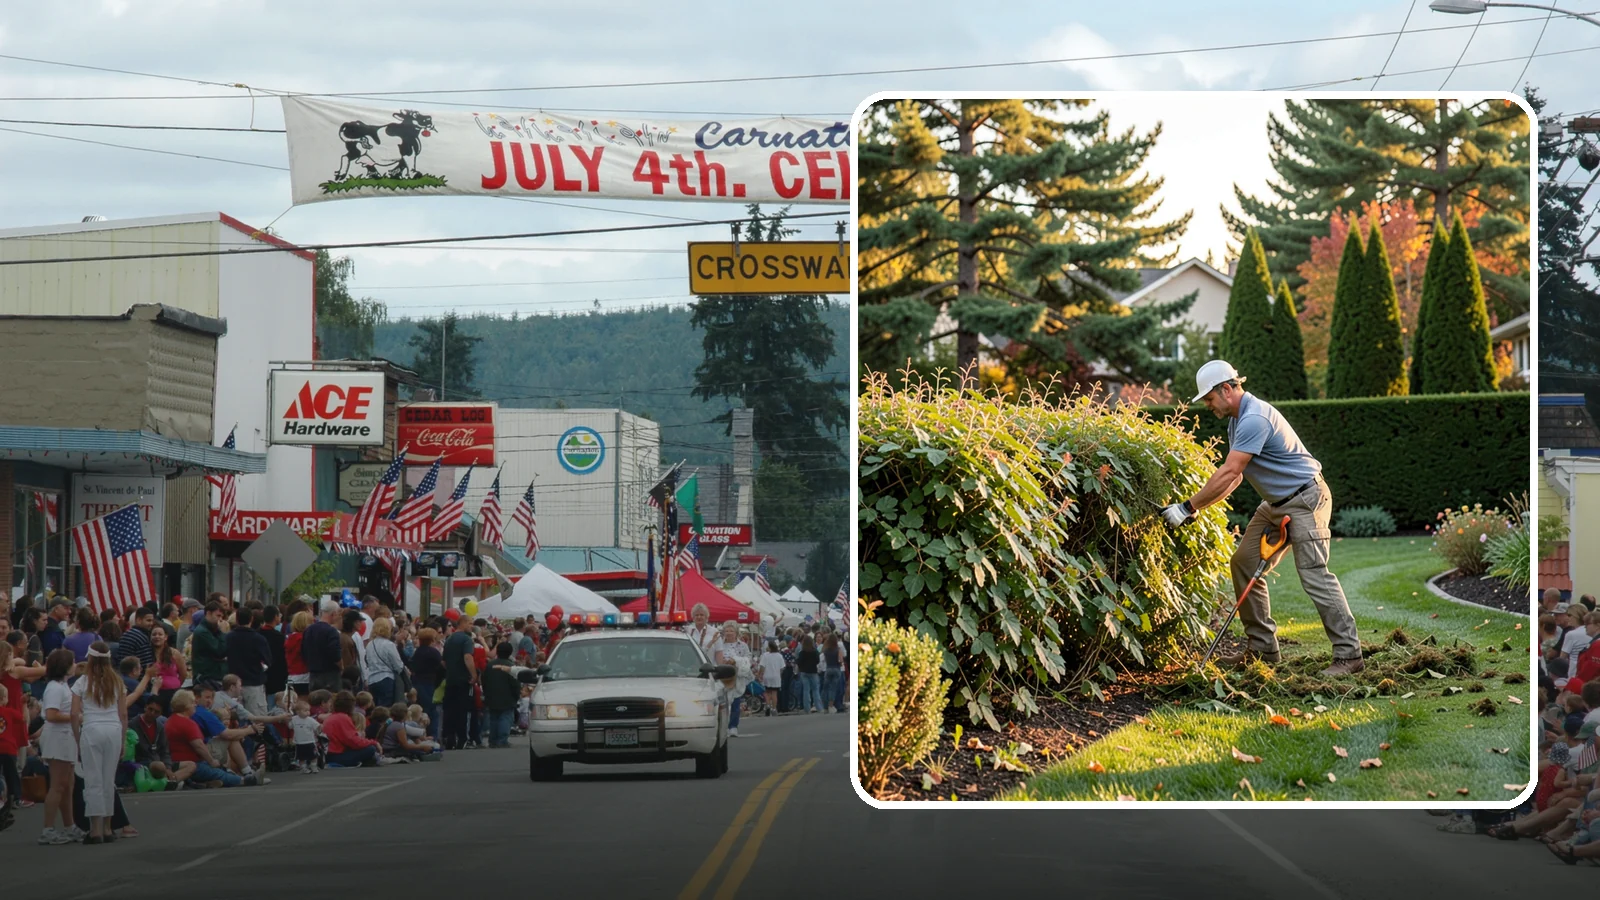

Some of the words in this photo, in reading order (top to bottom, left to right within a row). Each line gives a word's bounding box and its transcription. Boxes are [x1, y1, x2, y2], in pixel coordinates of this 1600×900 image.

[694, 121, 850, 150] Carnat
[481, 141, 605, 192] JULY
[632, 150, 746, 198] 4th.
[696, 254, 850, 280] CROSSWA
[283, 380, 373, 420] ACE
[405, 409, 452, 423] CEDAR
[461, 409, 485, 422] LOG
[283, 421, 371, 437] Hardware
[416, 428, 477, 447] Coca-Cola
[353, 467, 386, 480] Simpl
[96, 485, 124, 495] Vincent
[126, 486, 136, 495] de
[138, 486, 155, 495] Paul
[212, 516, 330, 535] HARDARE
[688, 527, 741, 535] CRNATION
[699, 535, 730, 543] GLASS
